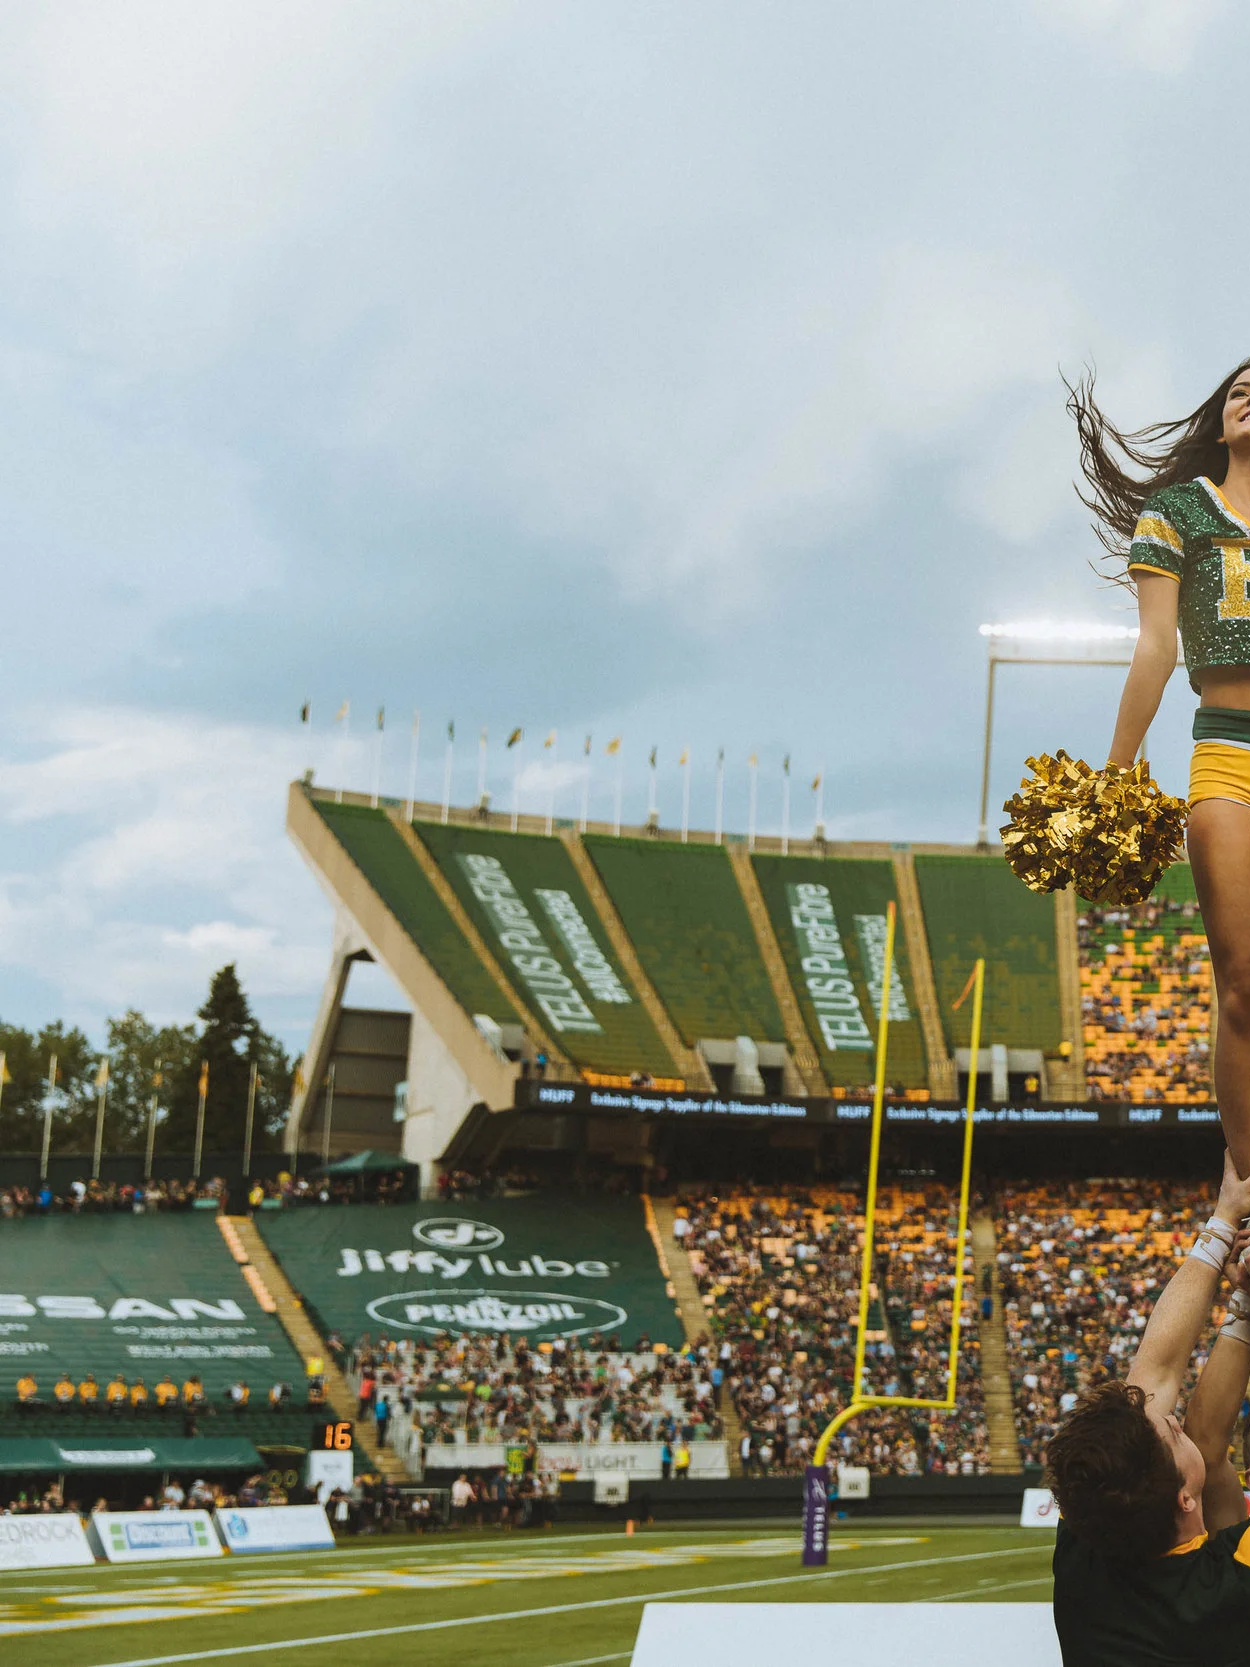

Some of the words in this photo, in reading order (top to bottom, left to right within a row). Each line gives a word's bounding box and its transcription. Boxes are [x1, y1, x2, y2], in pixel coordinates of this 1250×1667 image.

[465, 853, 551, 953] PureFibre
[791, 883, 850, 976] PureFibre
[511, 953, 602, 1034] TELUS
[806, 976, 875, 1051] TELUS
[336, 1248, 473, 1279] Jiffy
[478, 1253, 611, 1278] lube
[325, 1422, 352, 1450] 16
